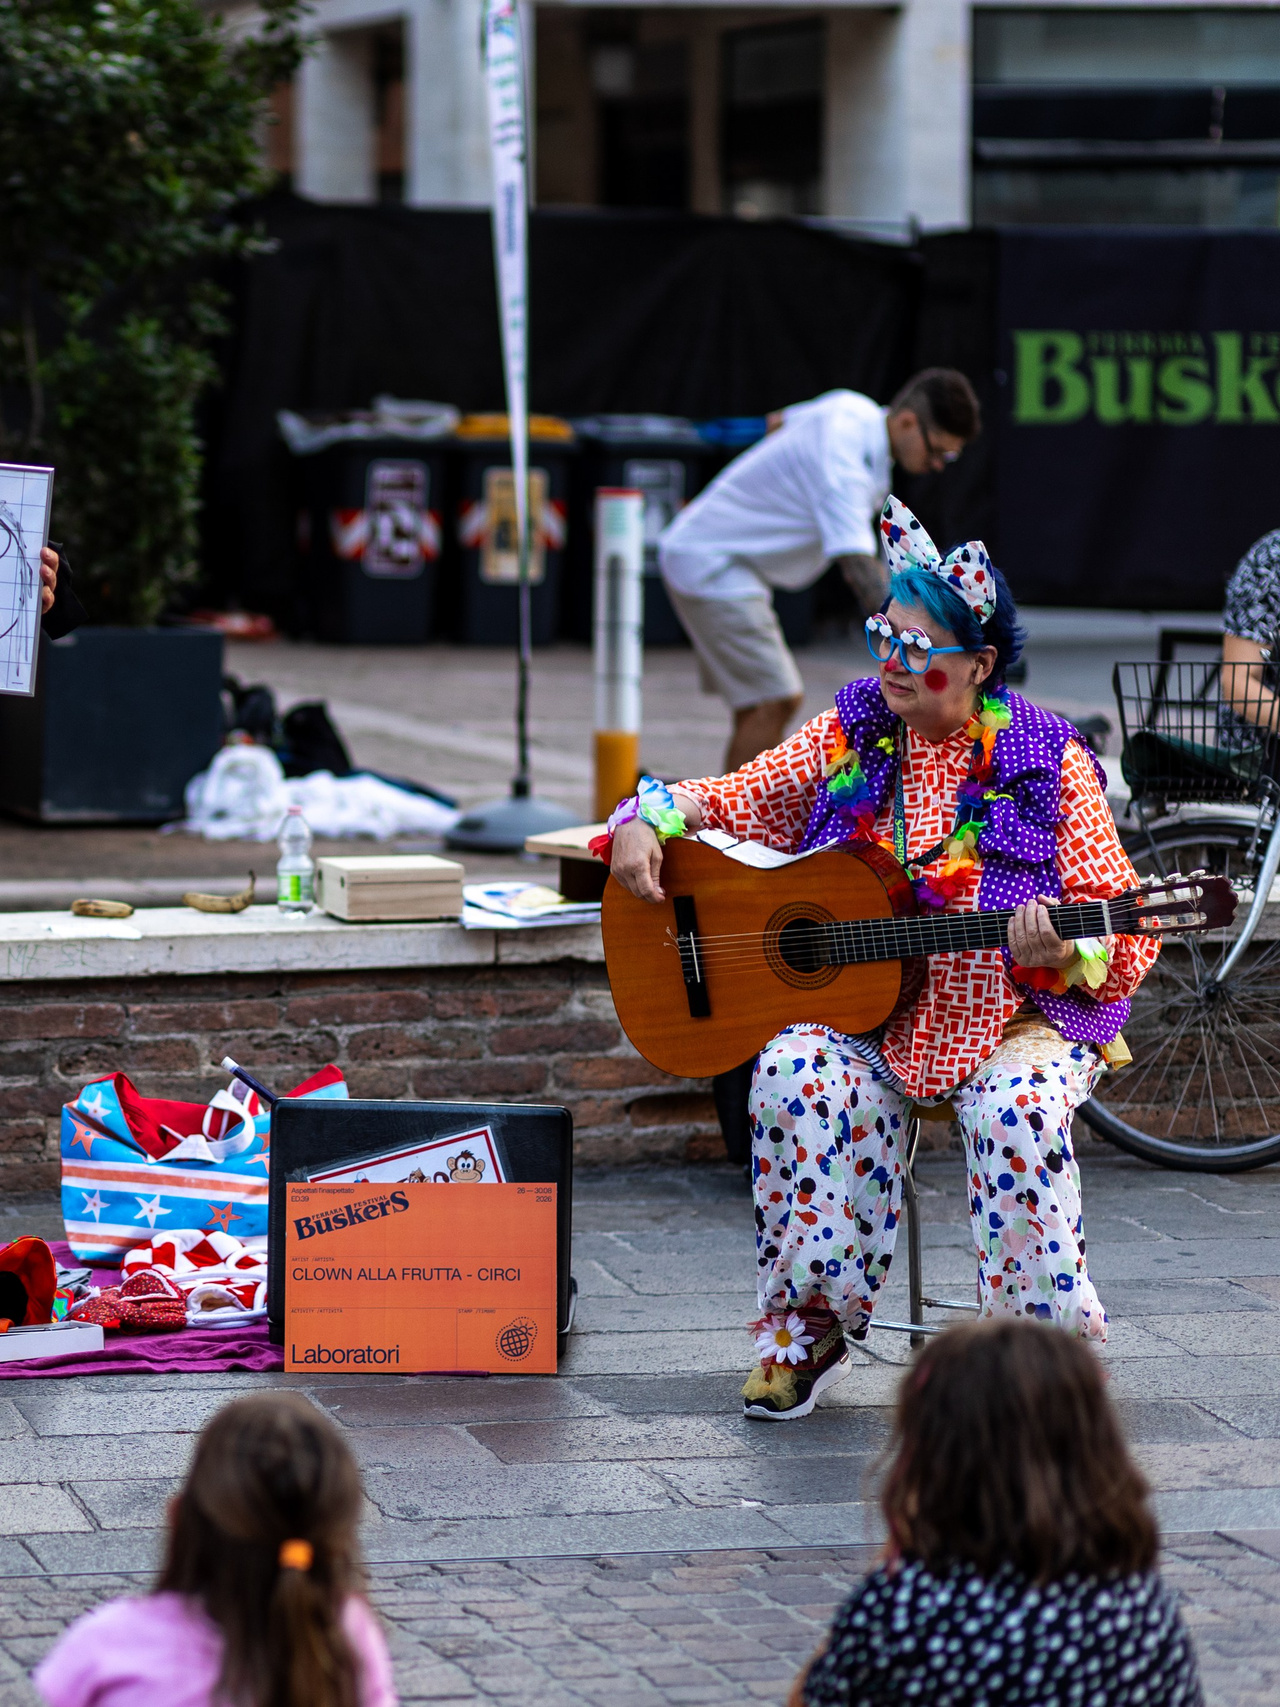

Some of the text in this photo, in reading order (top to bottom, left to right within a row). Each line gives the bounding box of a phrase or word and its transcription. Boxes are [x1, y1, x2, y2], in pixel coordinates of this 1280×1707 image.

[1012, 328, 1280, 427] Busk
[311, 1194, 388, 1220] FERRARA FESTIVAL
[535, 1195, 553, 1203] 2026
[292, 1267, 353, 1281] CLOWN
[356, 1267, 397, 1281] ALLA
[401, 1267, 462, 1281] FRUTTA
[477, 1267, 521, 1281] CIRCI
[292, 1344, 400, 1364] Laboratori
